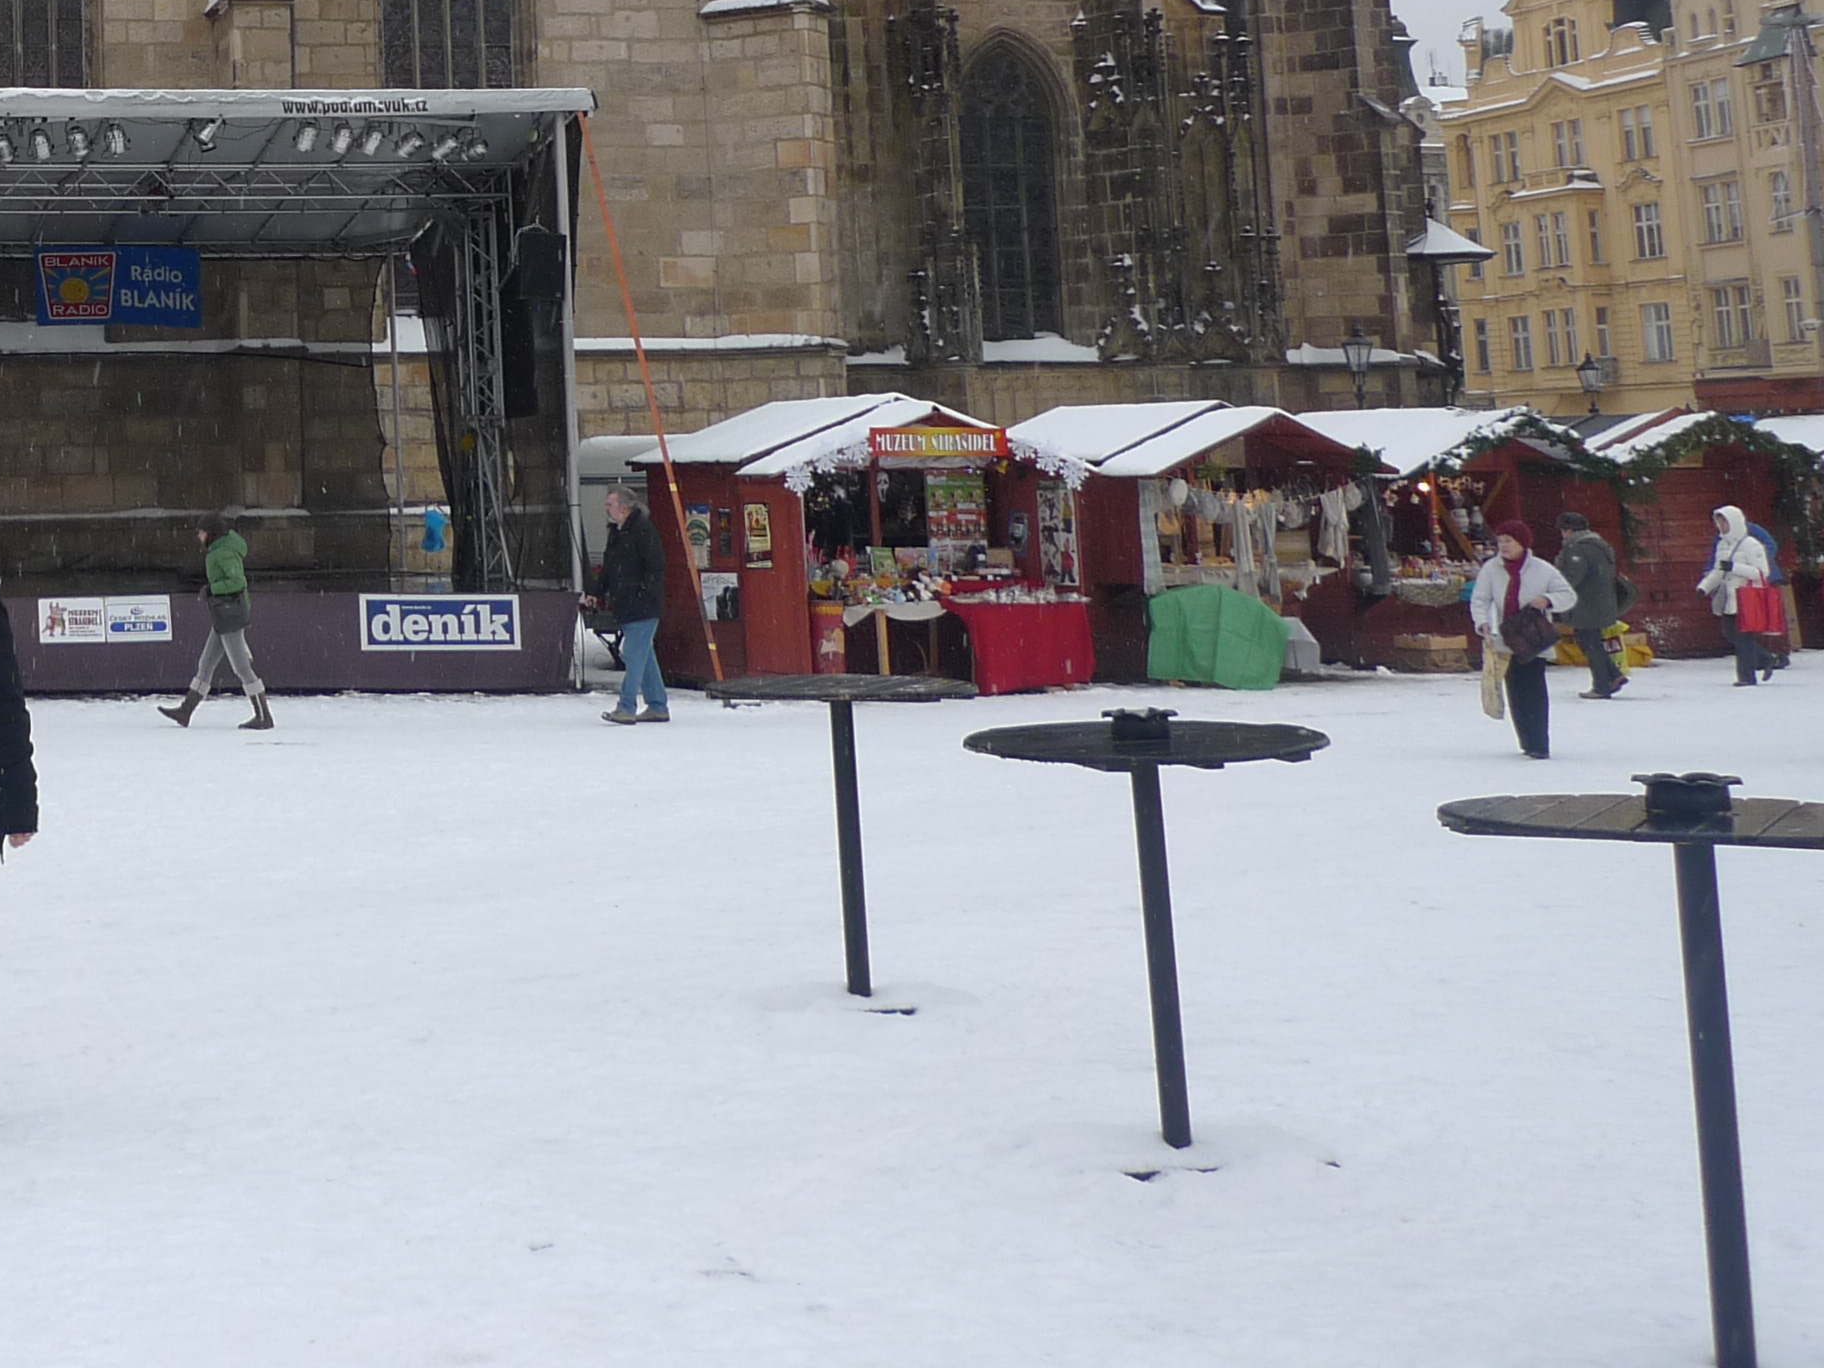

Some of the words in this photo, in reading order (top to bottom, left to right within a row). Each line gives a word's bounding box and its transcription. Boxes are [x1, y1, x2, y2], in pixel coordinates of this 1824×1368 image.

[130, 263, 183, 283] Rádio
[120, 287, 196, 311] BLANÍK
[52, 304, 108, 316] RADIO
[876, 433, 926, 451] MUZEUM
[371, 604, 510, 642] deník
